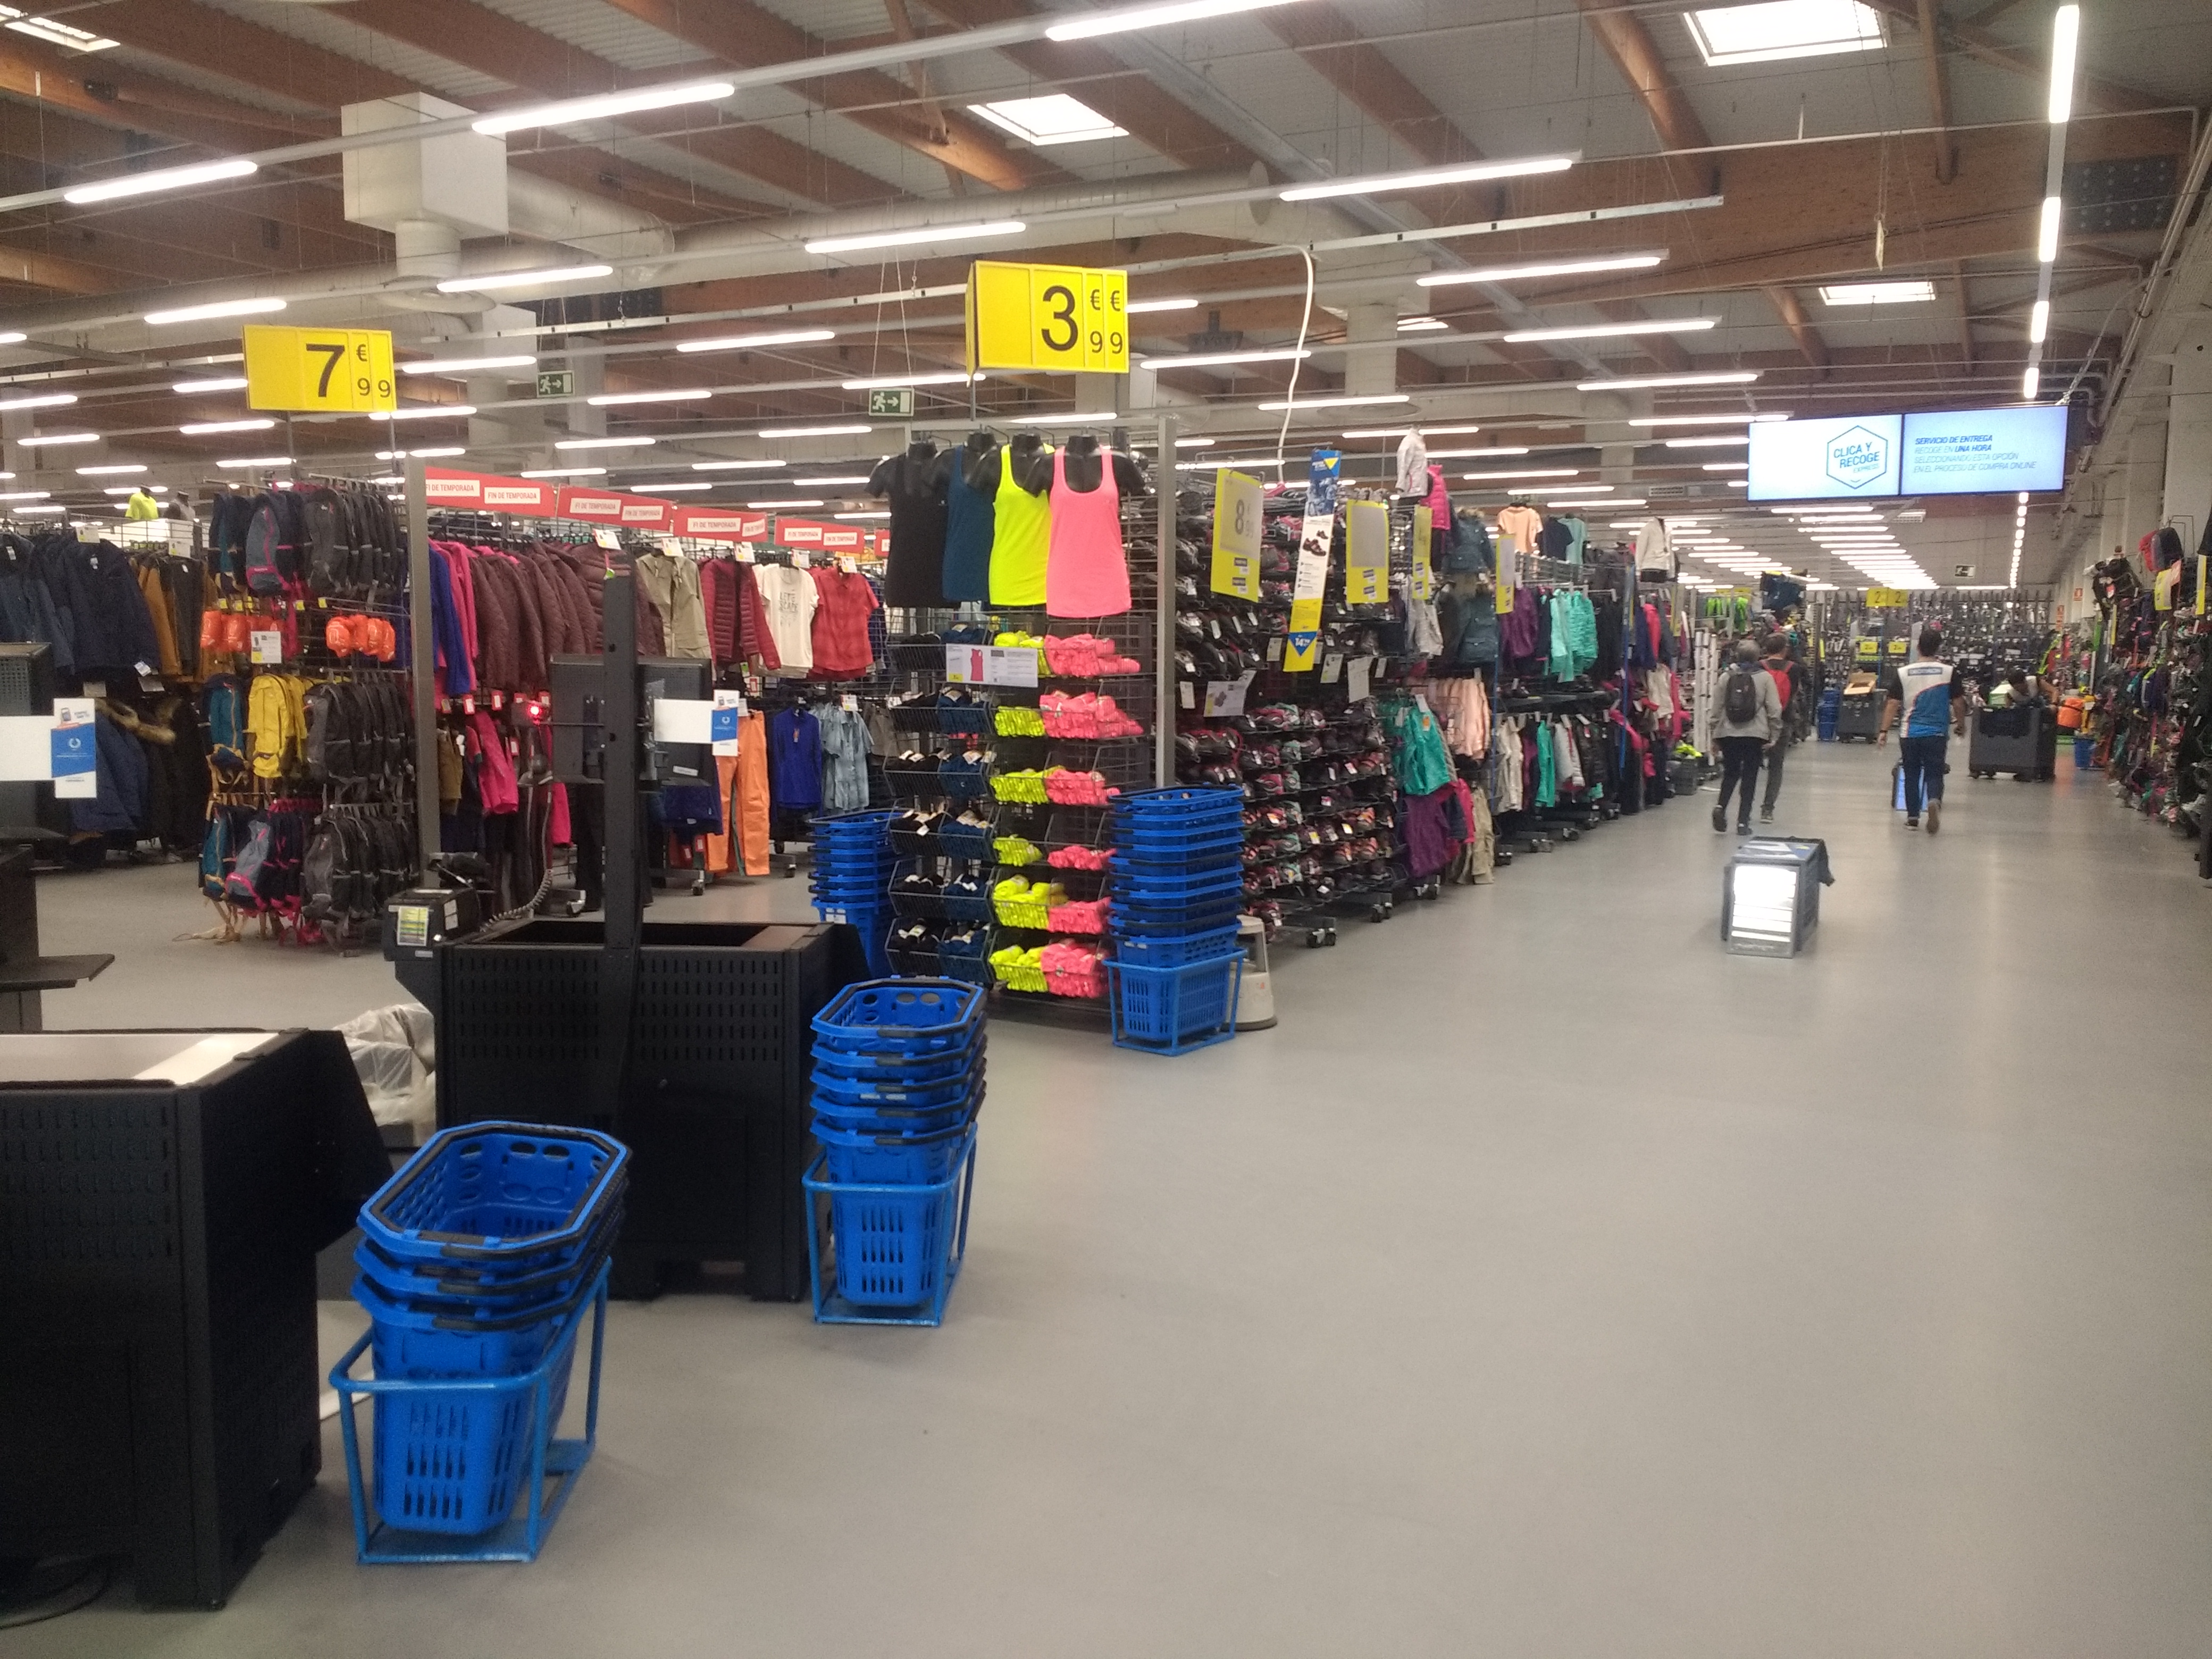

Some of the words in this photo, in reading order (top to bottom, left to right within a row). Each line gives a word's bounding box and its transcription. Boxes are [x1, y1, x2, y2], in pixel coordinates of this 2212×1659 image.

[1041, 285, 1078, 351] 3
[306, 343, 345, 398] 7
[1833, 444, 1862, 458] CLICA
[1865, 441, 1873, 451] Y
[1840, 451, 1880, 468] RECOGE
